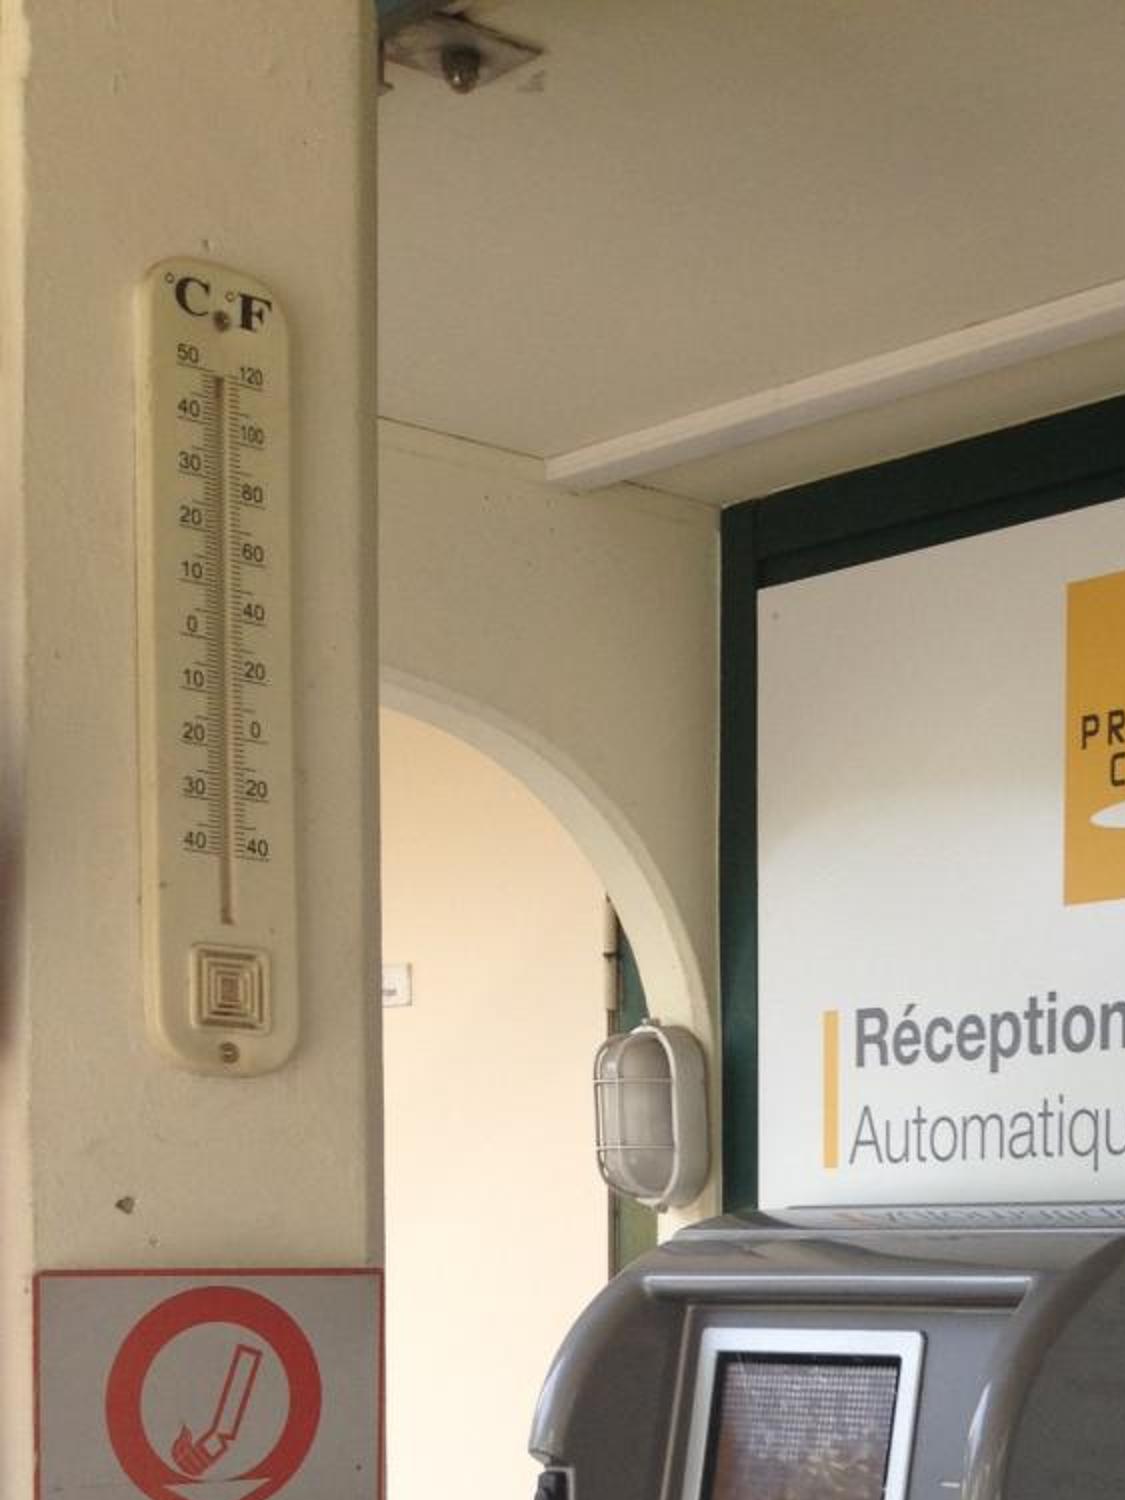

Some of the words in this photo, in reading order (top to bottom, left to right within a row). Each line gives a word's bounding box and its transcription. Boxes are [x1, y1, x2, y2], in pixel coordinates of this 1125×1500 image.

[177, 343, 199, 364] 50
[240, 366, 263, 387] 120
[177, 399, 200, 418] 40
[240, 425, 265, 445] 100
[178, 451, 201, 472] 30
[241, 484, 263, 503] 80
[179, 505, 202, 526] 20
[242, 542, 264, 563] 60
[181, 560, 203, 579] 10
[243, 603, 265, 622] 40
[186, 614, 198, 634] 0
[183, 668, 204, 688] 10
[243, 661, 266, 682] 20
[182, 722, 205, 743] 20
[250, 720, 261, 739] 0
[183, 776, 205, 797] 30
[245, 779, 268, 799] 20
[183, 831, 207, 850] 40
[247, 838, 269, 858] 40
